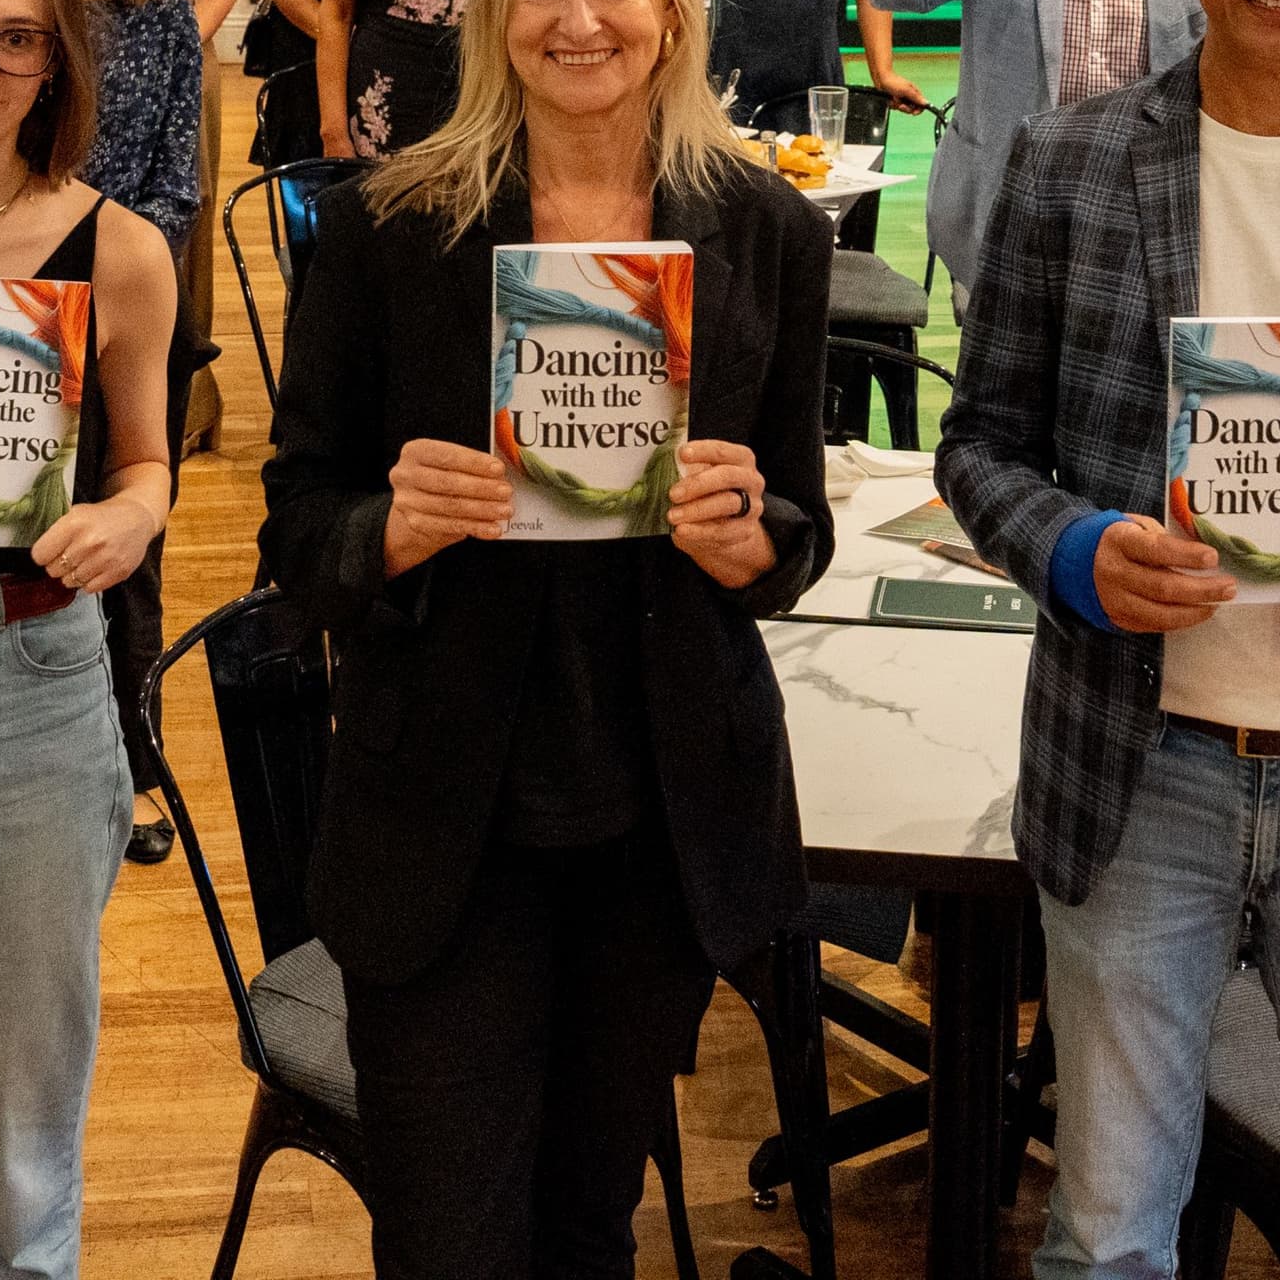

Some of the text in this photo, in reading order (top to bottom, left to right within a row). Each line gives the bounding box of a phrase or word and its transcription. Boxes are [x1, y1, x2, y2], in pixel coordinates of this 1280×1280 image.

[513, 337, 670, 384] Dancing
[541, 382, 641, 407] with the
[0, 399, 36, 423] the
[511, 410, 669, 449] Universe
[1214, 450, 1268, 475] with
[504, 518, 544, 533] Jeevak
